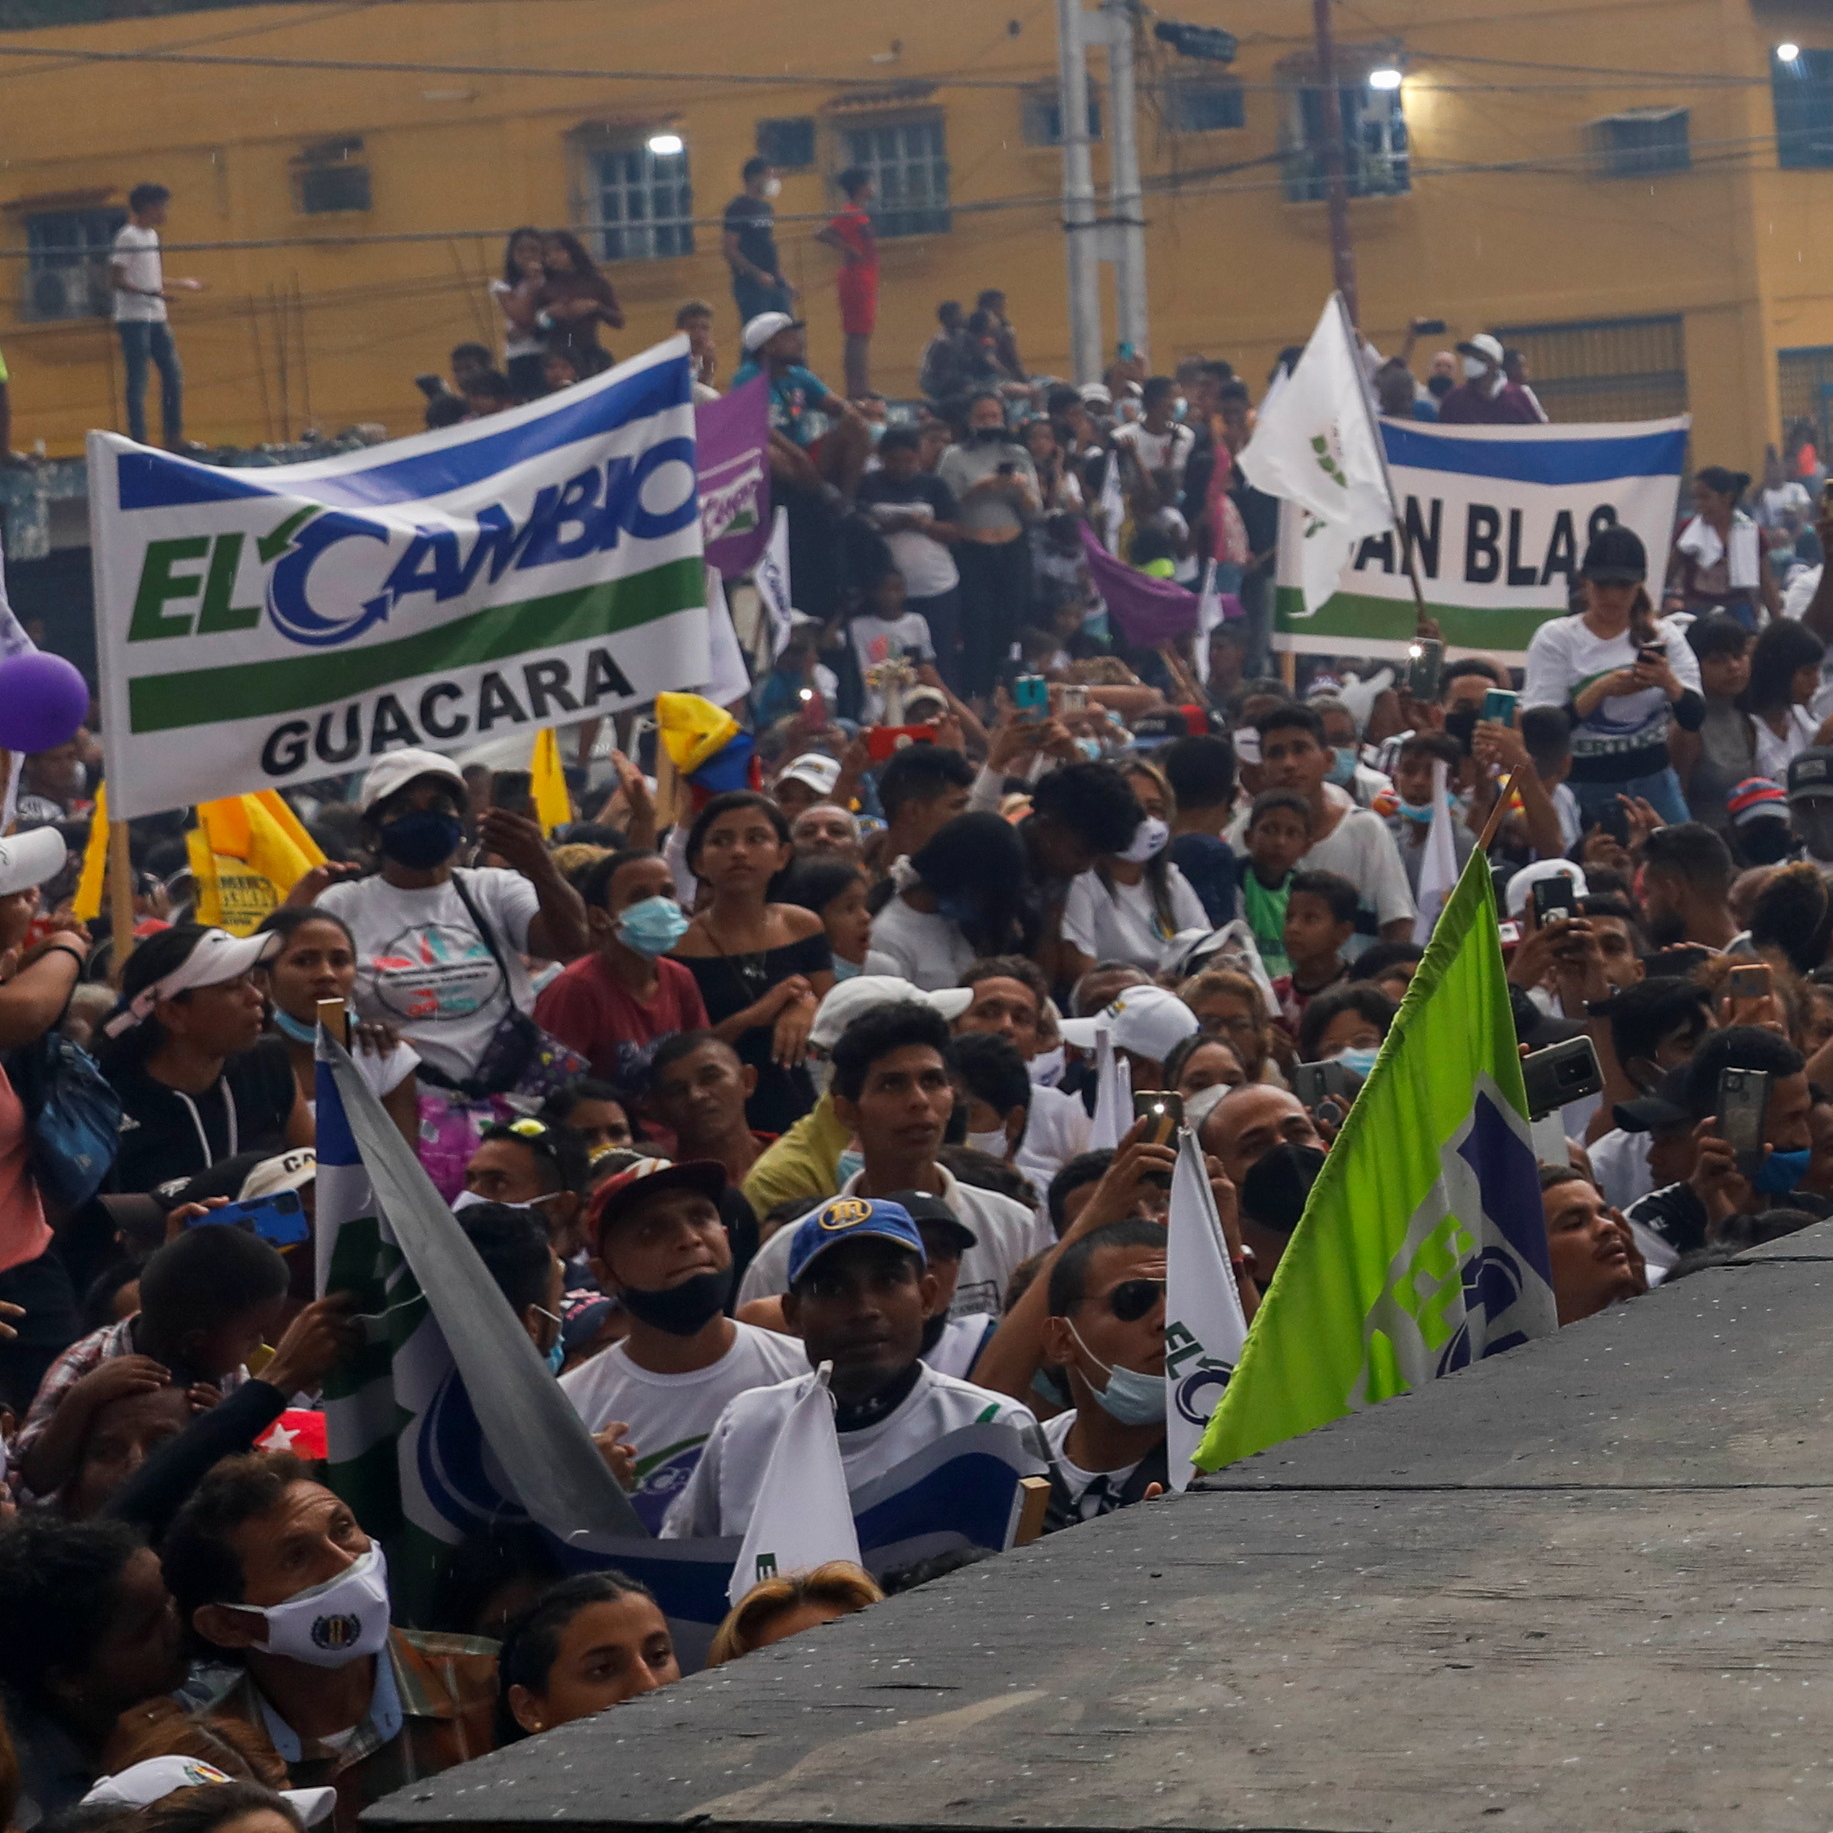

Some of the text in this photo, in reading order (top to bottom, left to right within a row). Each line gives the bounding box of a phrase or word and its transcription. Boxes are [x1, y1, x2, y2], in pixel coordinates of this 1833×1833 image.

[128, 436, 697, 647] EL CAMBIO
[260, 647, 636, 777] GUACARA
